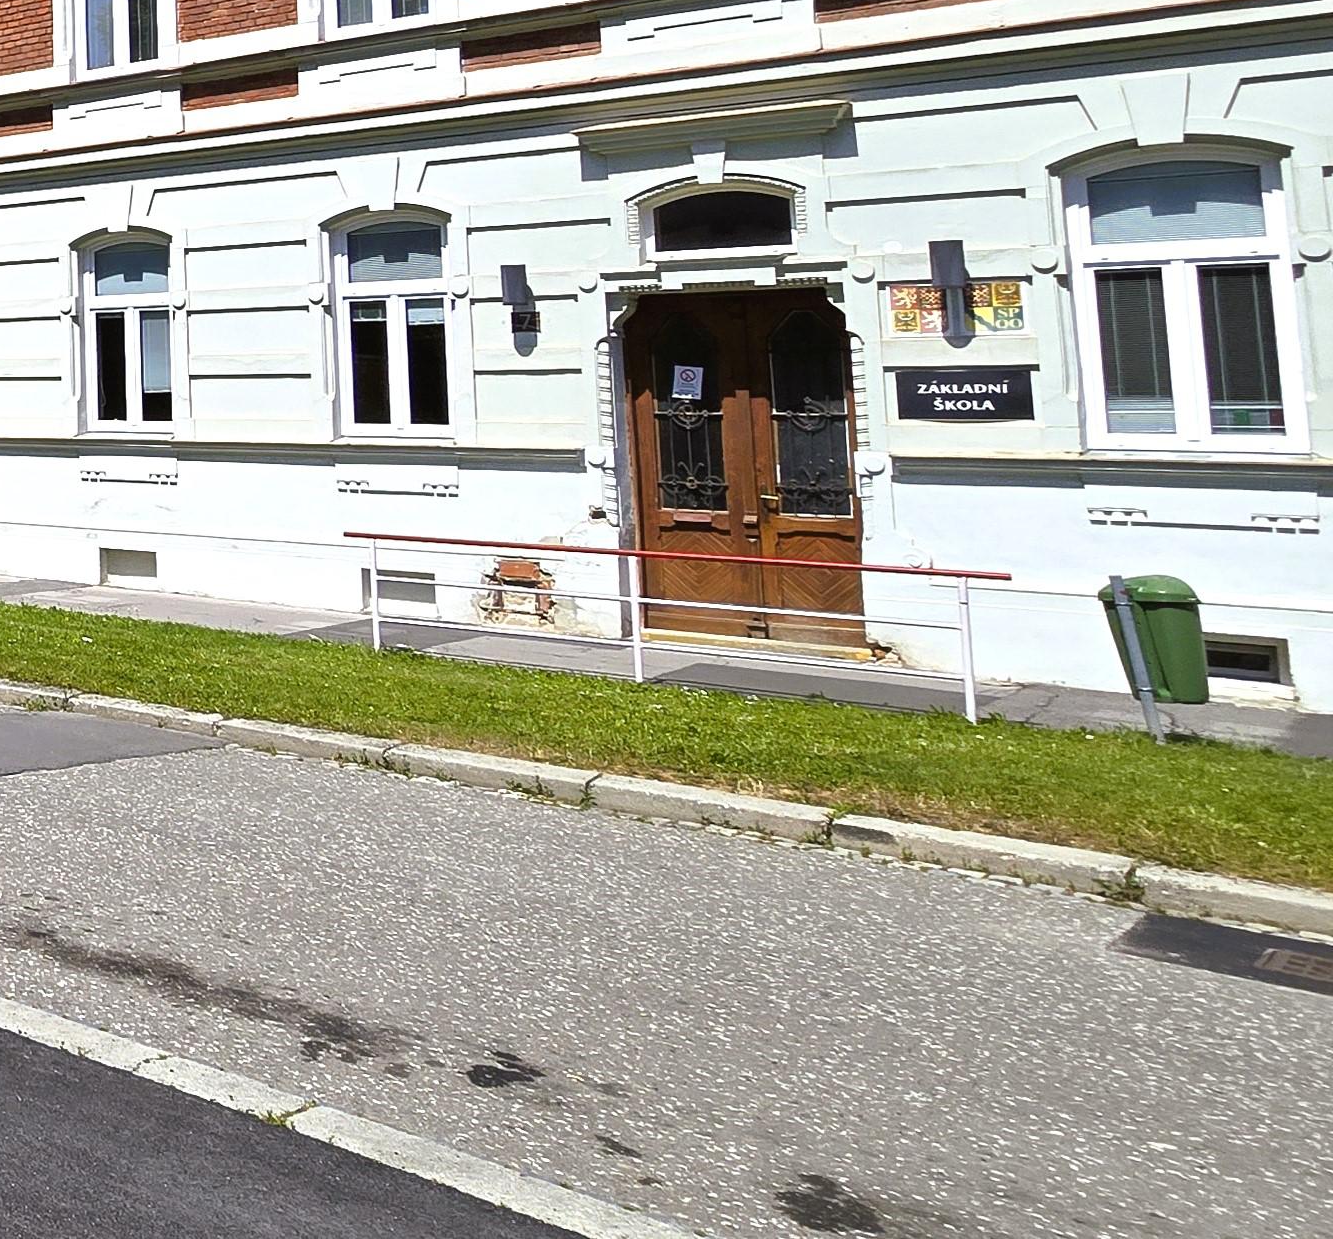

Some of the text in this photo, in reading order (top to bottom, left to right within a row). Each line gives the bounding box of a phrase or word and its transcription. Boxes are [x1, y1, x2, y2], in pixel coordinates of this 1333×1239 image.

[997, 307, 1020, 318] SP
[518, 313, 531, 330] 7
[916, 380, 1010, 394] ZÁKLADNÍ
[933, 396, 995, 411] ŠKOLA
